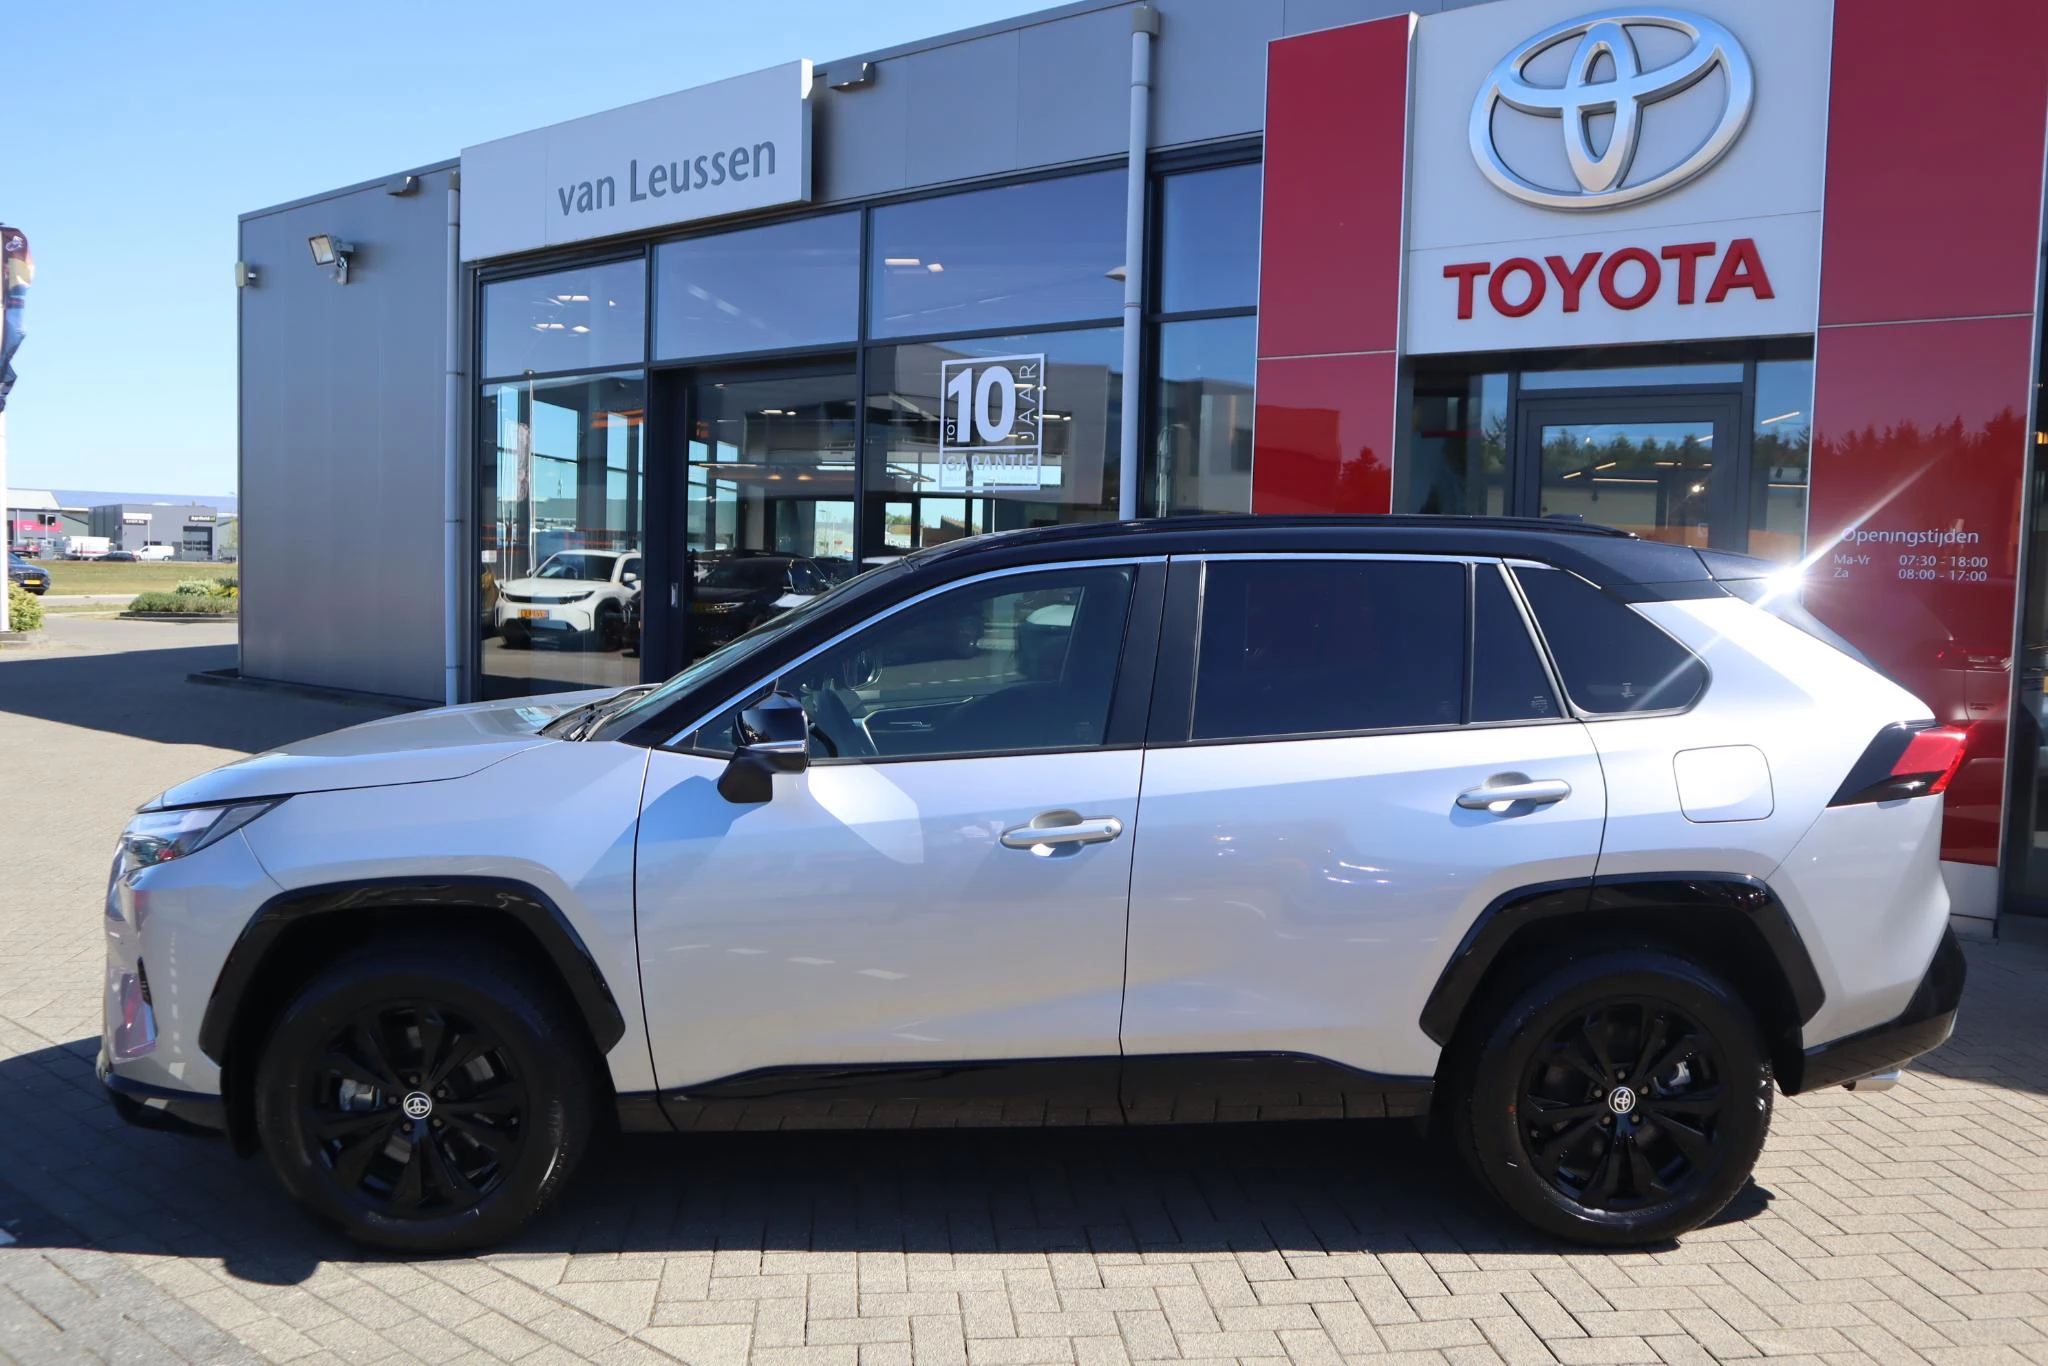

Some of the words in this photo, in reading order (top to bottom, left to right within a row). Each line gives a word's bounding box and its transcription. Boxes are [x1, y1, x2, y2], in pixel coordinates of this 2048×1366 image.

[558, 174, 615, 216] van
[629, 140, 776, 203] Leussen
[1443, 238, 1775, 320] TOYOTA
[947, 365, 1017, 443] 10
[1018, 363, 1037, 441] JAAR
[946, 417, 956, 443] TOT
[946, 453, 1035, 472] GARANTIE
[1842, 527, 1979, 547] Openingstijden
[1834, 554, 1871, 565] Ma-Vr
[1899, 555, 1937, 566] 07:30
[1951, 556, 1988, 568] 18:00
[1834, 568, 1849, 578] Za
[1898, 569, 1936, 580] 08:00
[1950, 570, 1988, 581] 17:00
